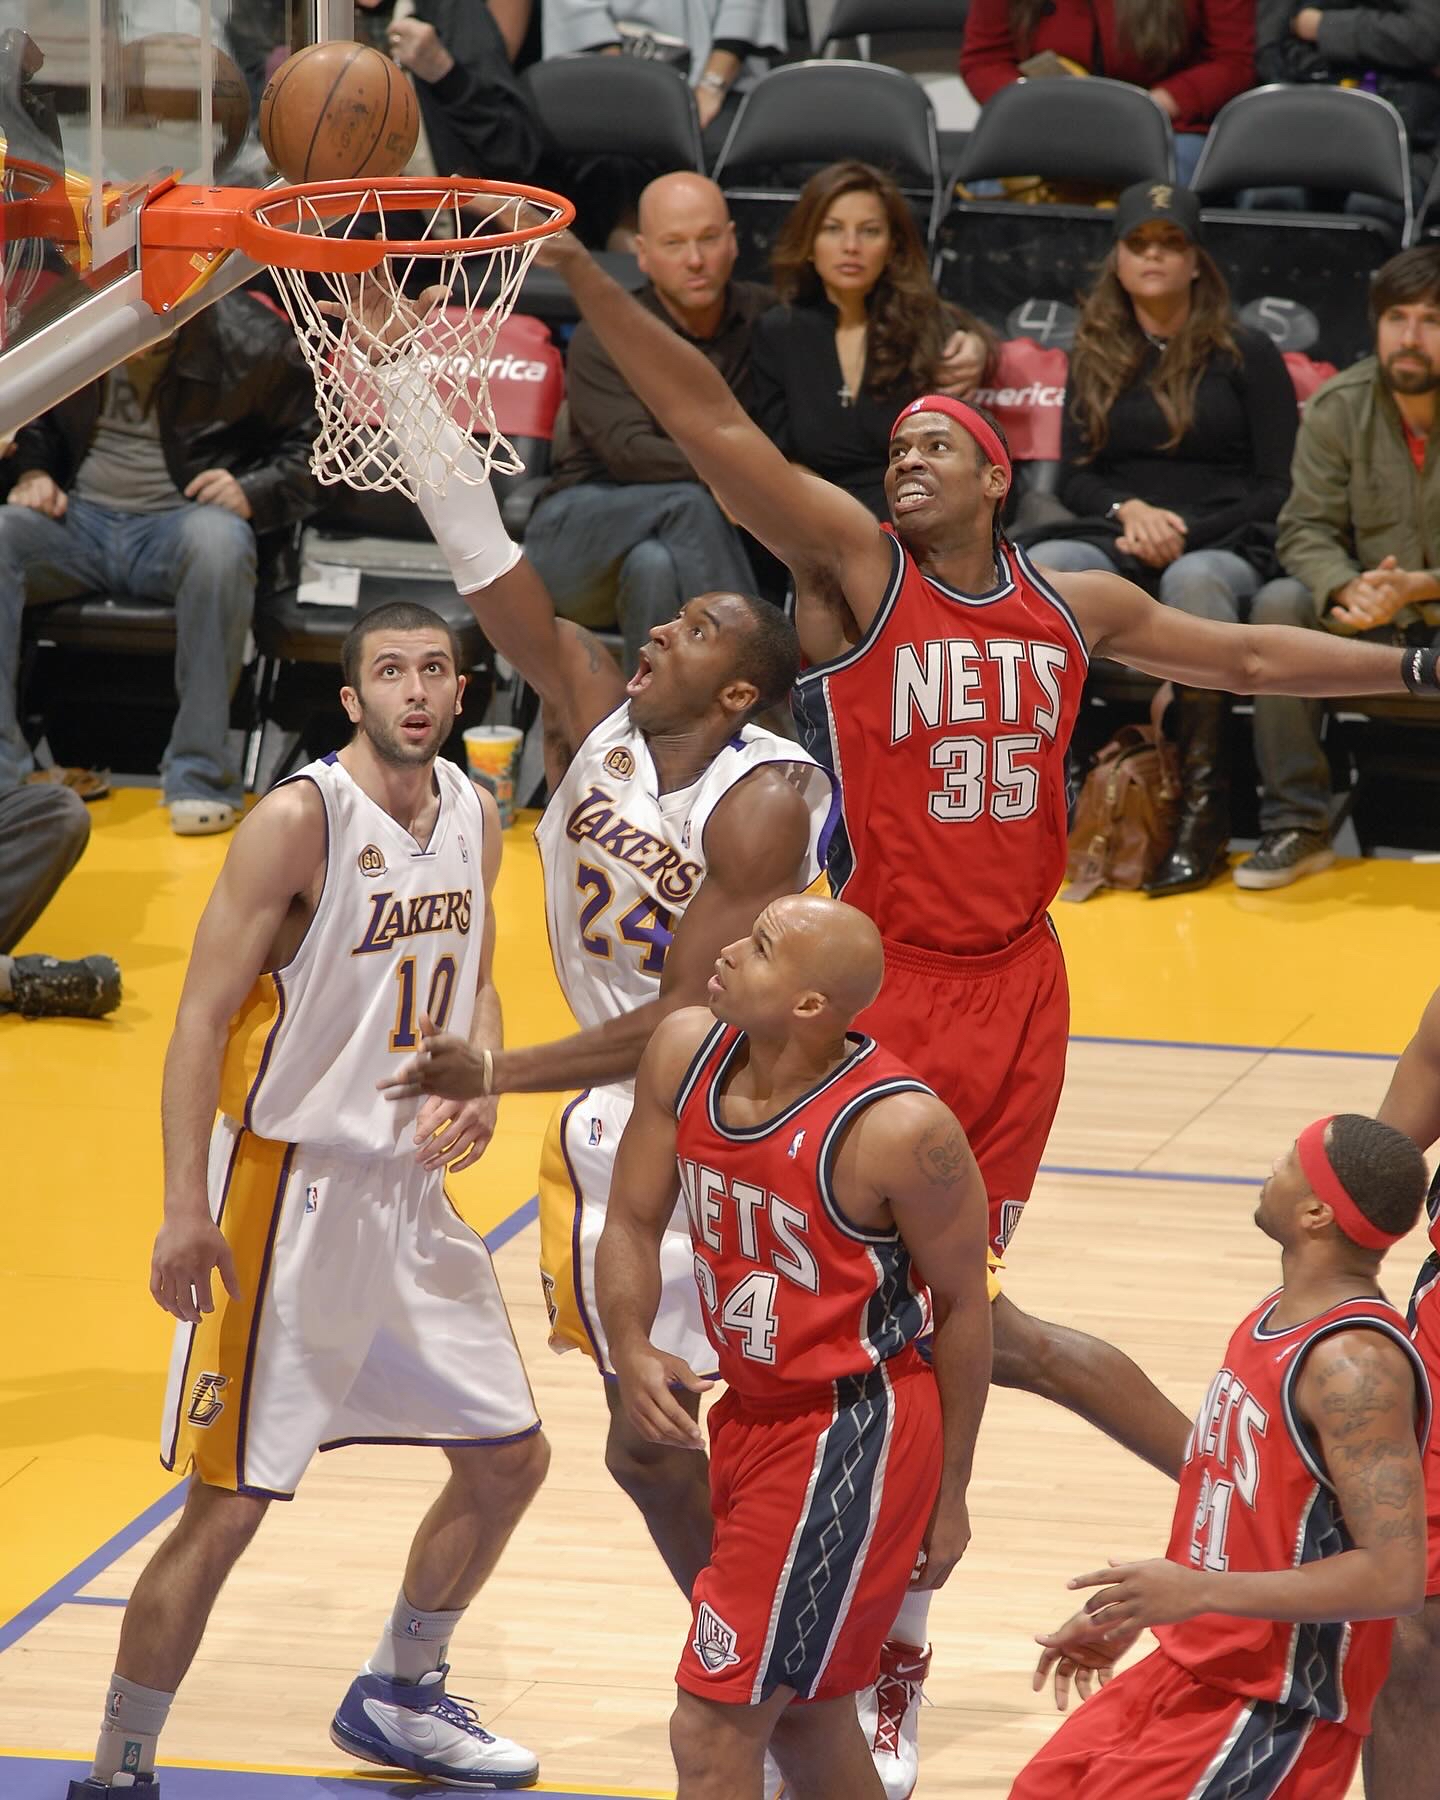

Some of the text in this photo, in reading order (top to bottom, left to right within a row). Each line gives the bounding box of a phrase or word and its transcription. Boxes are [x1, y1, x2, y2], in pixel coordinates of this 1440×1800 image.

[1018, 298, 1057, 342] 4
[1258, 297, 1296, 342] 5
[890, 638, 1068, 746] NETS
[927, 734, 1042, 823] 35
[575, 857, 675, 975] 24
[389, 953, 460, 1052] 10
[677, 1153, 820, 1296] NETS
[1184, 1367, 1270, 1513] NETS
[1189, 1468, 1236, 1572] 21
[702, 1611, 731, 1653] NETS
